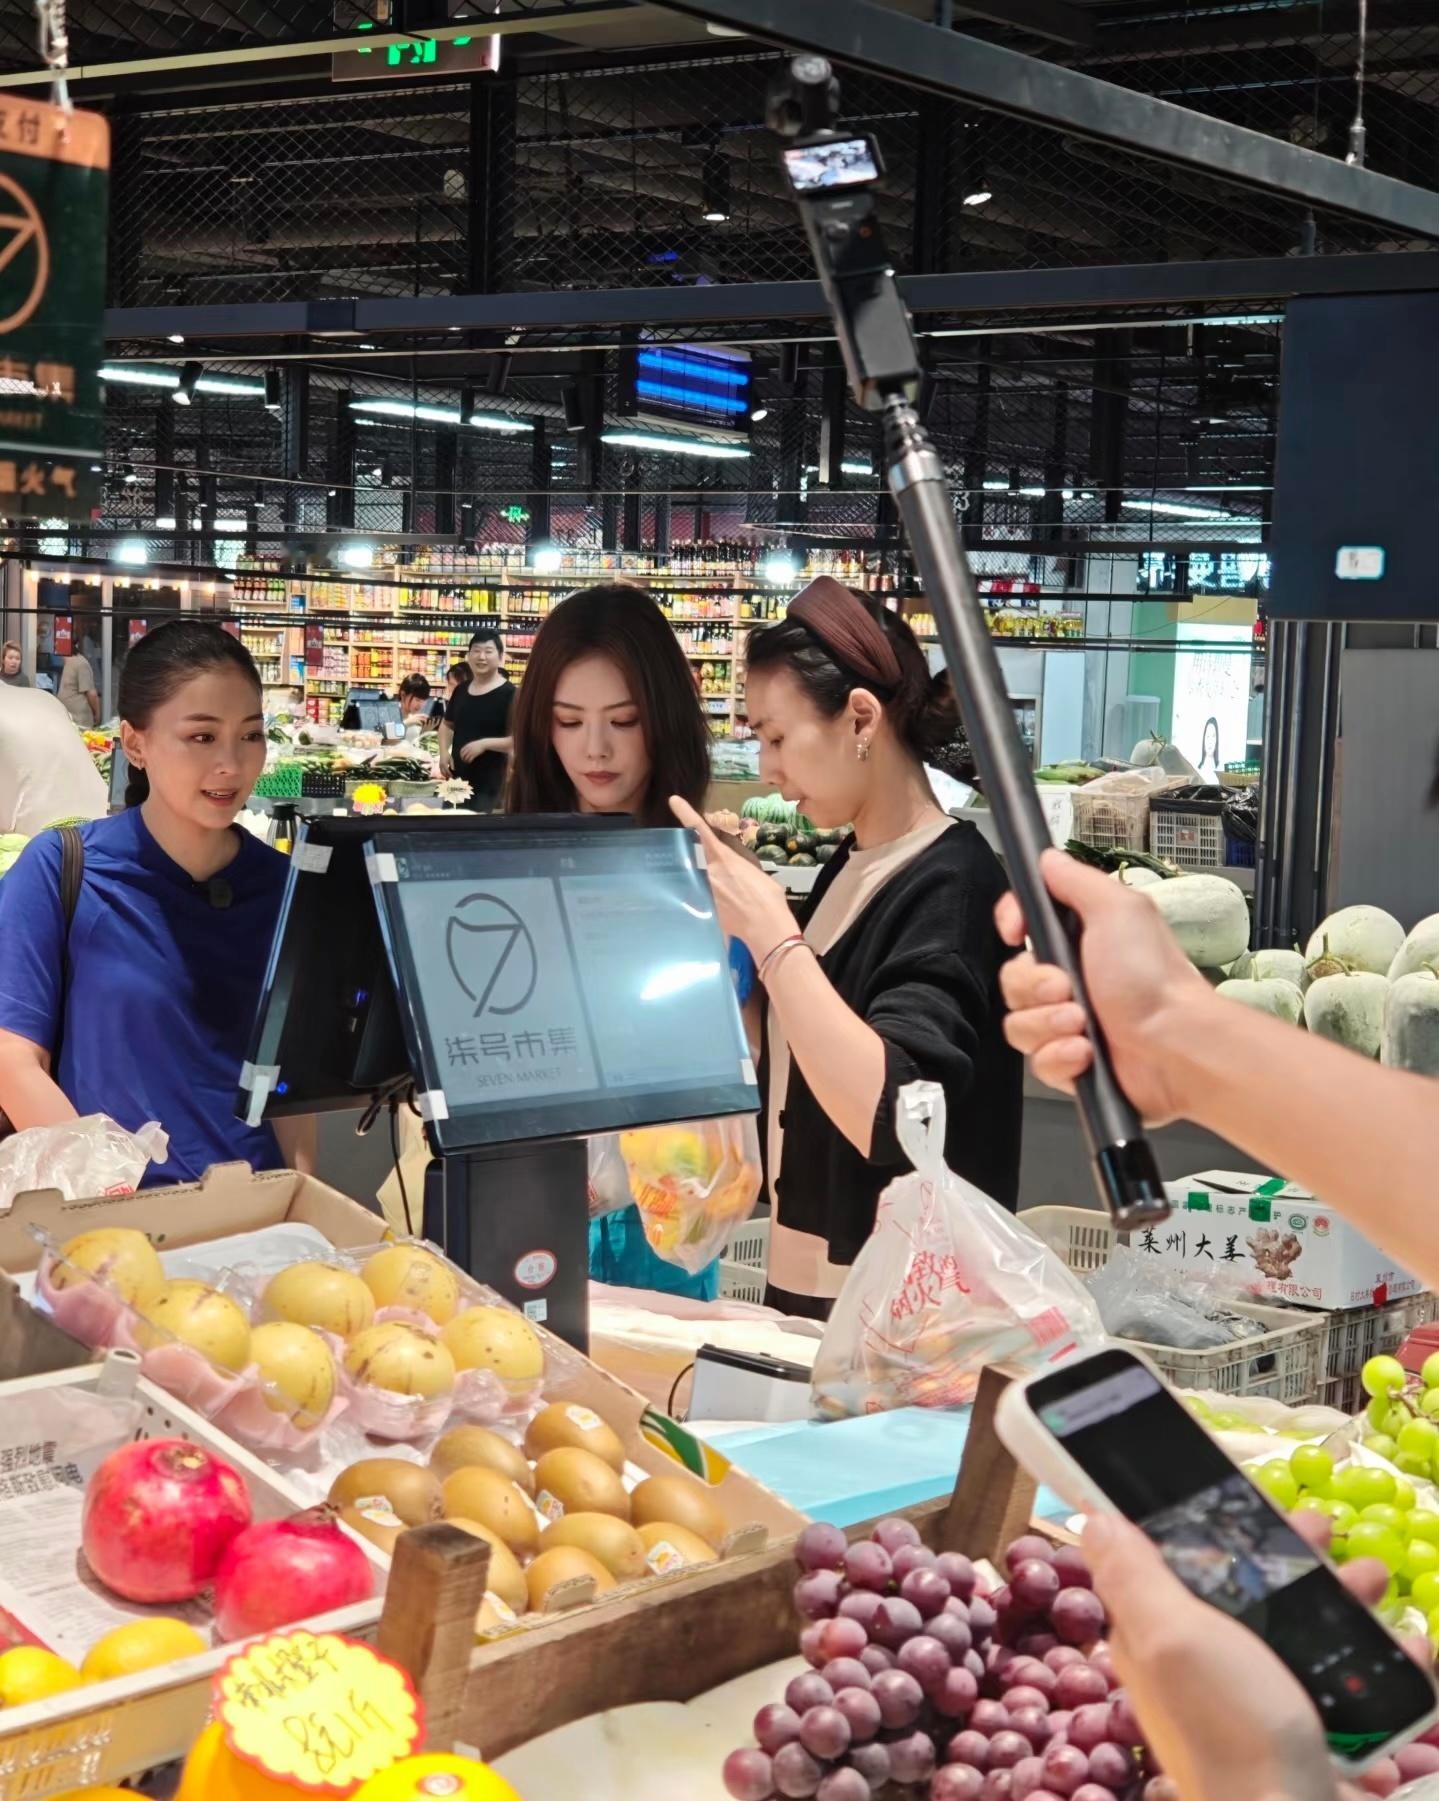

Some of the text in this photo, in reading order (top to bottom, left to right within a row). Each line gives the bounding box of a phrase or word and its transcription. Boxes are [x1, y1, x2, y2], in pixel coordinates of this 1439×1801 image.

[445, 1027, 577, 1067] 柒号市集
[477, 1066, 562, 1088] SEVEN MARKET
[1138, 1226, 1246, 1263] 莱州大姜
